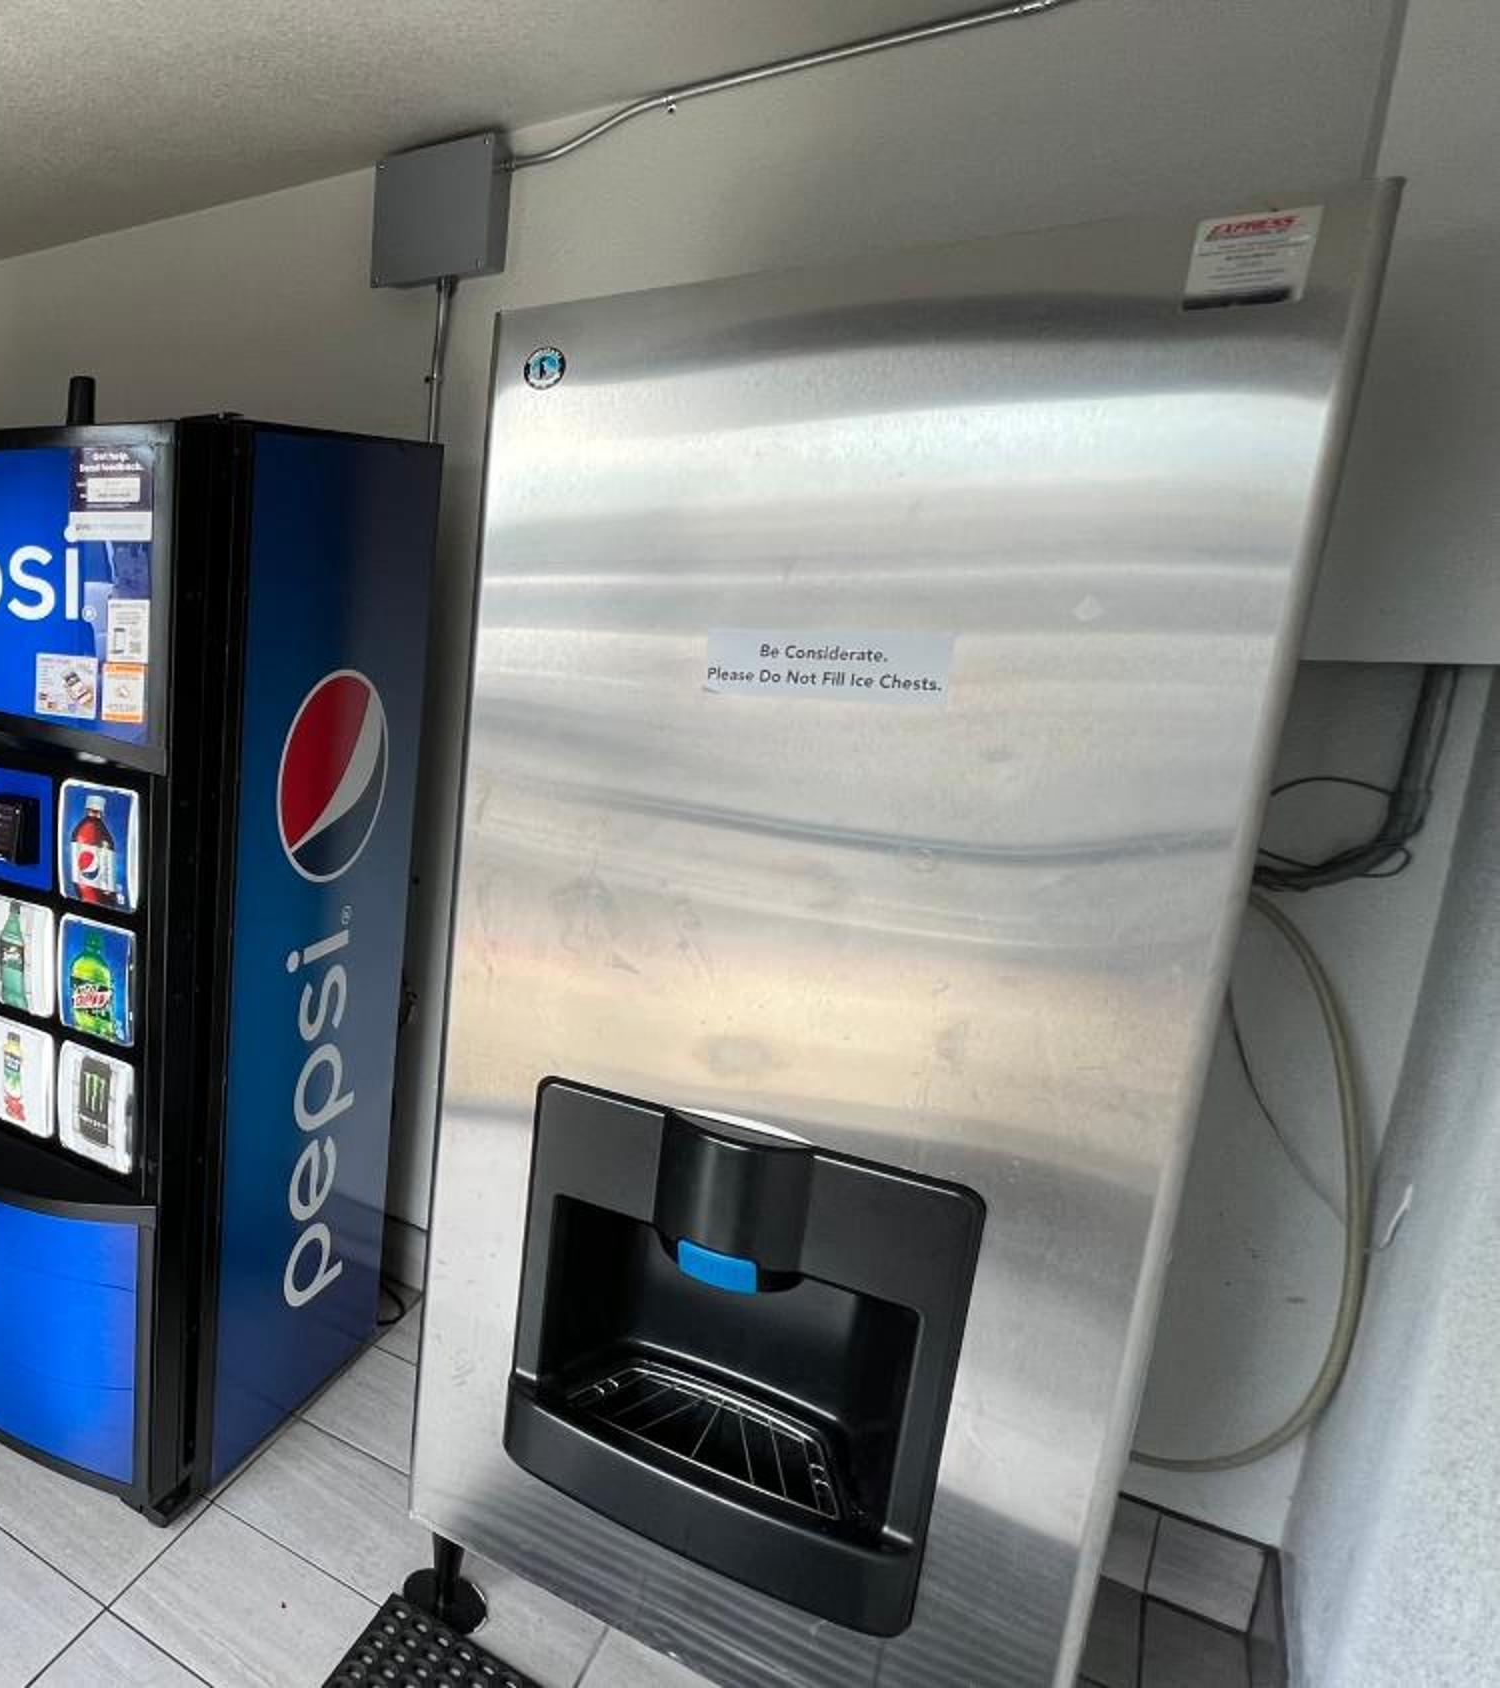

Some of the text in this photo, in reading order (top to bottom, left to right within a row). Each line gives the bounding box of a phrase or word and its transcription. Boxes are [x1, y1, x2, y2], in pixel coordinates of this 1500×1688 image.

[759, 644, 888, 663] Be Considerate.
[707, 667, 942, 691] Please Do Not Fill Ice Chests.
[284, 930, 356, 1307] pepsi
